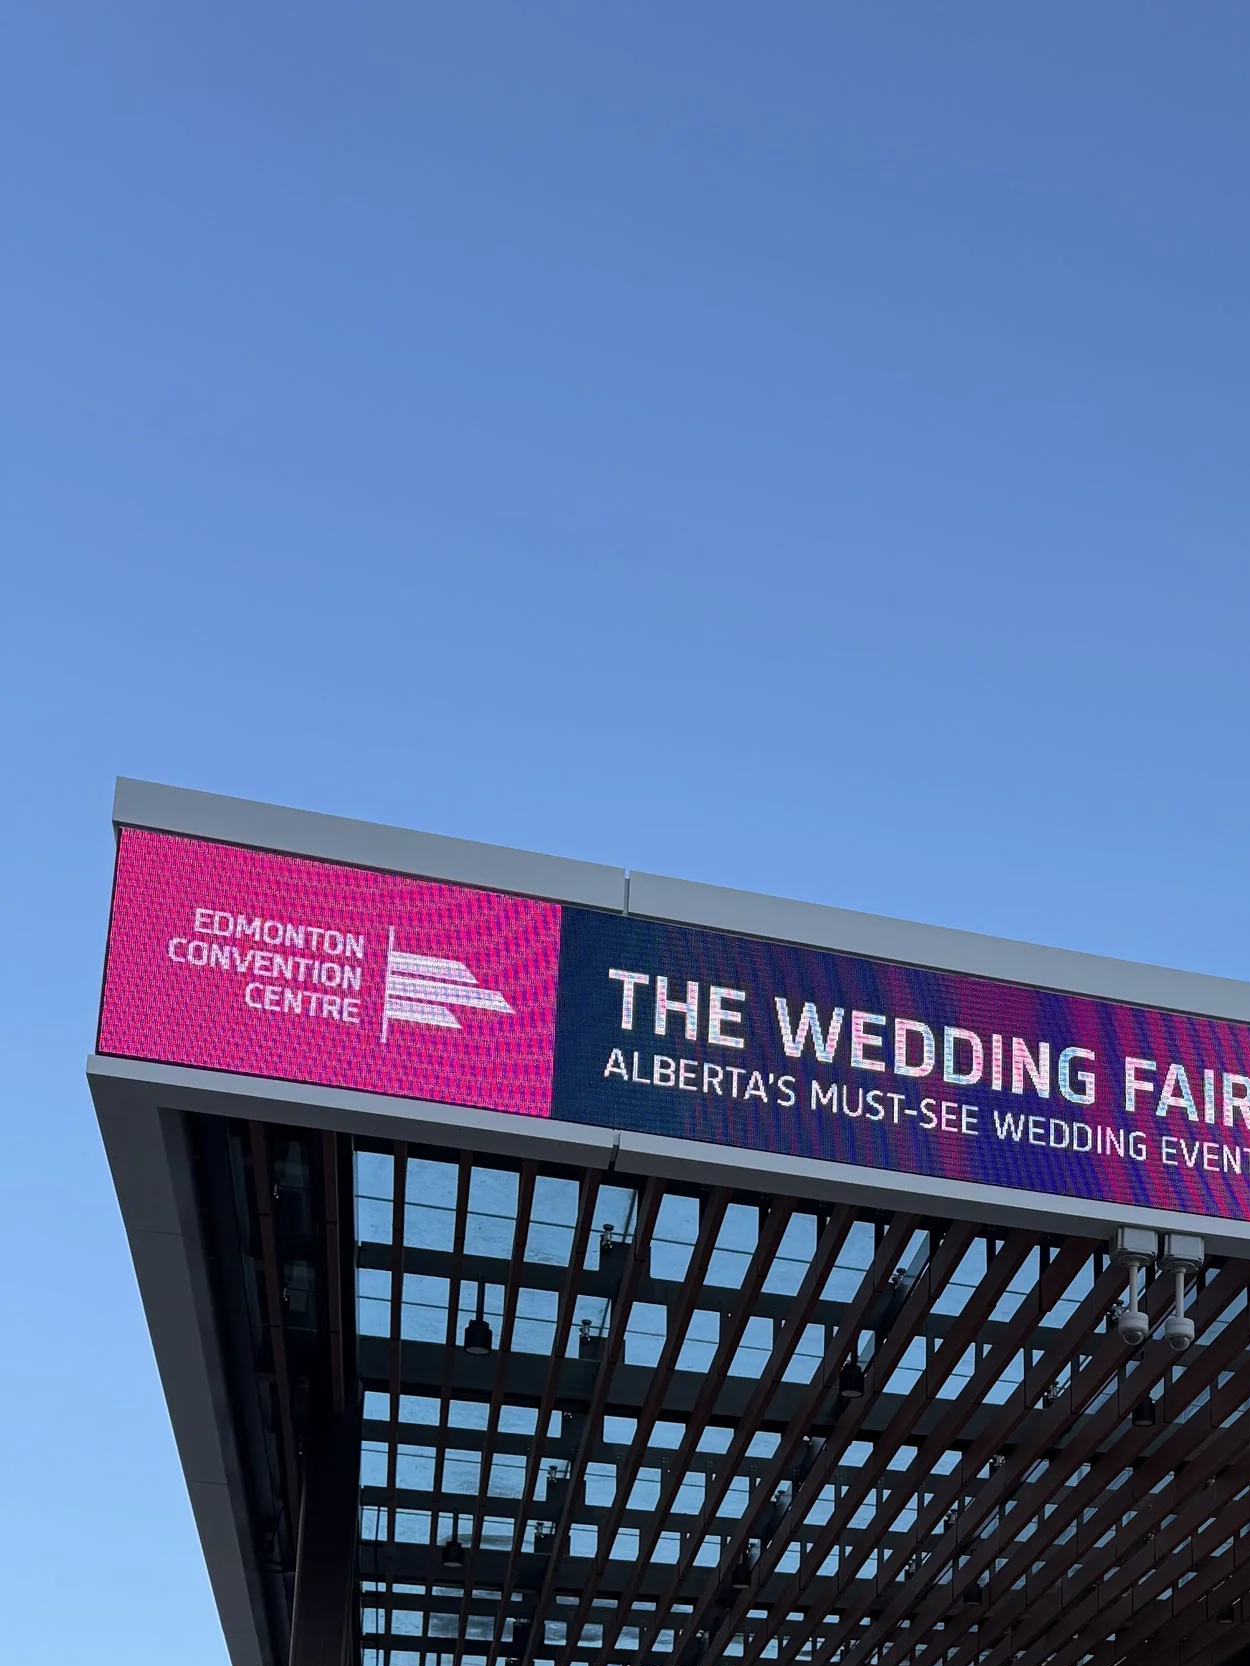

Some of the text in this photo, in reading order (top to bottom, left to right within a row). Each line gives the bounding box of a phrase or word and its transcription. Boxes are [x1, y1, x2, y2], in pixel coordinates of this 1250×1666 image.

[194, 908, 365, 959] EDMONTON
[167, 937, 362, 990] CONVENTION
[245, 982, 361, 1023] CENTRE
[608, 968, 746, 1049] THE
[774, 996, 1096, 1106] WEDDING
[603, 1048, 796, 1107] ALBERTA'S
[811, 1079, 979, 1136] MUST-SEE
[993, 1109, 1147, 1162] WEDDING
